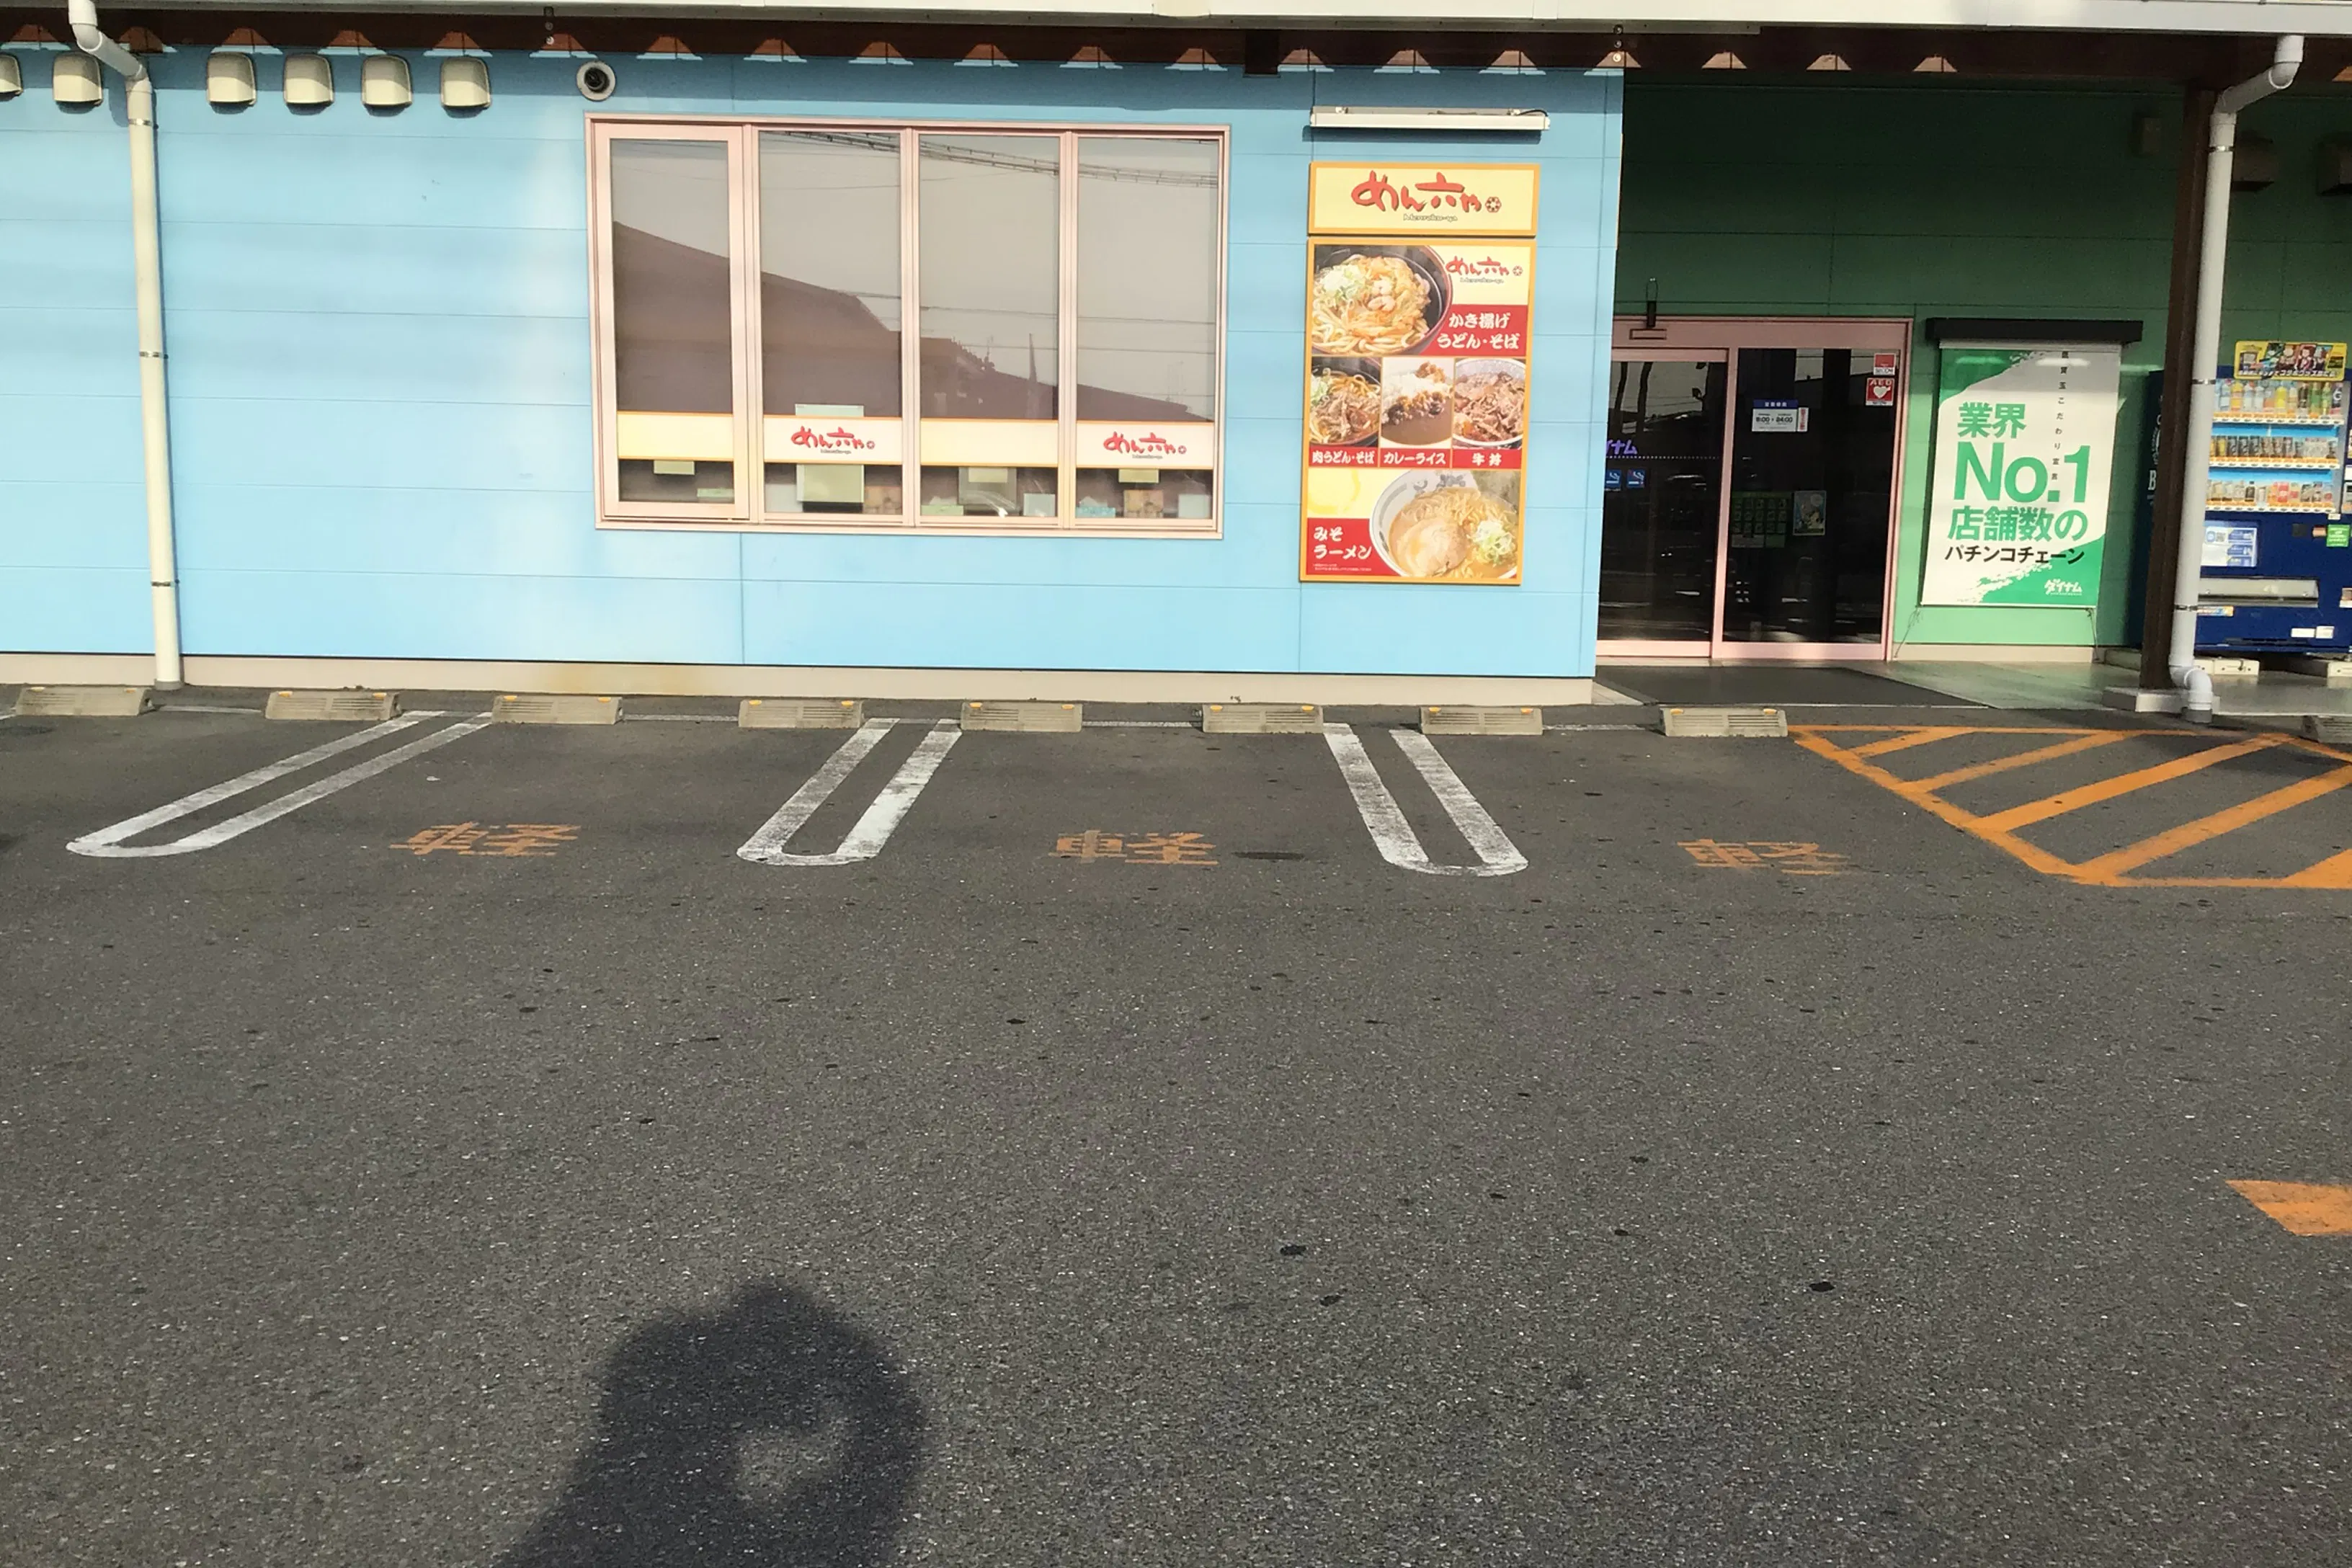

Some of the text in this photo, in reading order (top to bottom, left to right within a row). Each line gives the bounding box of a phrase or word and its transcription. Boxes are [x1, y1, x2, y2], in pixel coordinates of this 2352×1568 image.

[1351, 170, 1482, 213] めん六や
[1446, 256, 1510, 276] めん六や
[1448, 312, 1511, 329] かき揚げ
[1437, 332, 1520, 349] うどん・そば
[1957, 401, 2027, 439] 業界
[790, 425, 865, 450] めん六や
[1103, 431, 1176, 455] めん六や
[1312, 448, 1376, 465] 肉うどん・そば
[1384, 450, 1446, 465] カレーライス
[1471, 452, 1502, 466] 牛丼
[1954, 441, 2091, 503] No.1
[1947, 504, 2089, 541] 店舗数の
[1314, 526, 1344, 542] みそ
[1314, 544, 1372, 560] ラーメン
[1944, 545, 2085, 565] パチンコチェーン
[2044, 579, 2082, 595] ダイナム
